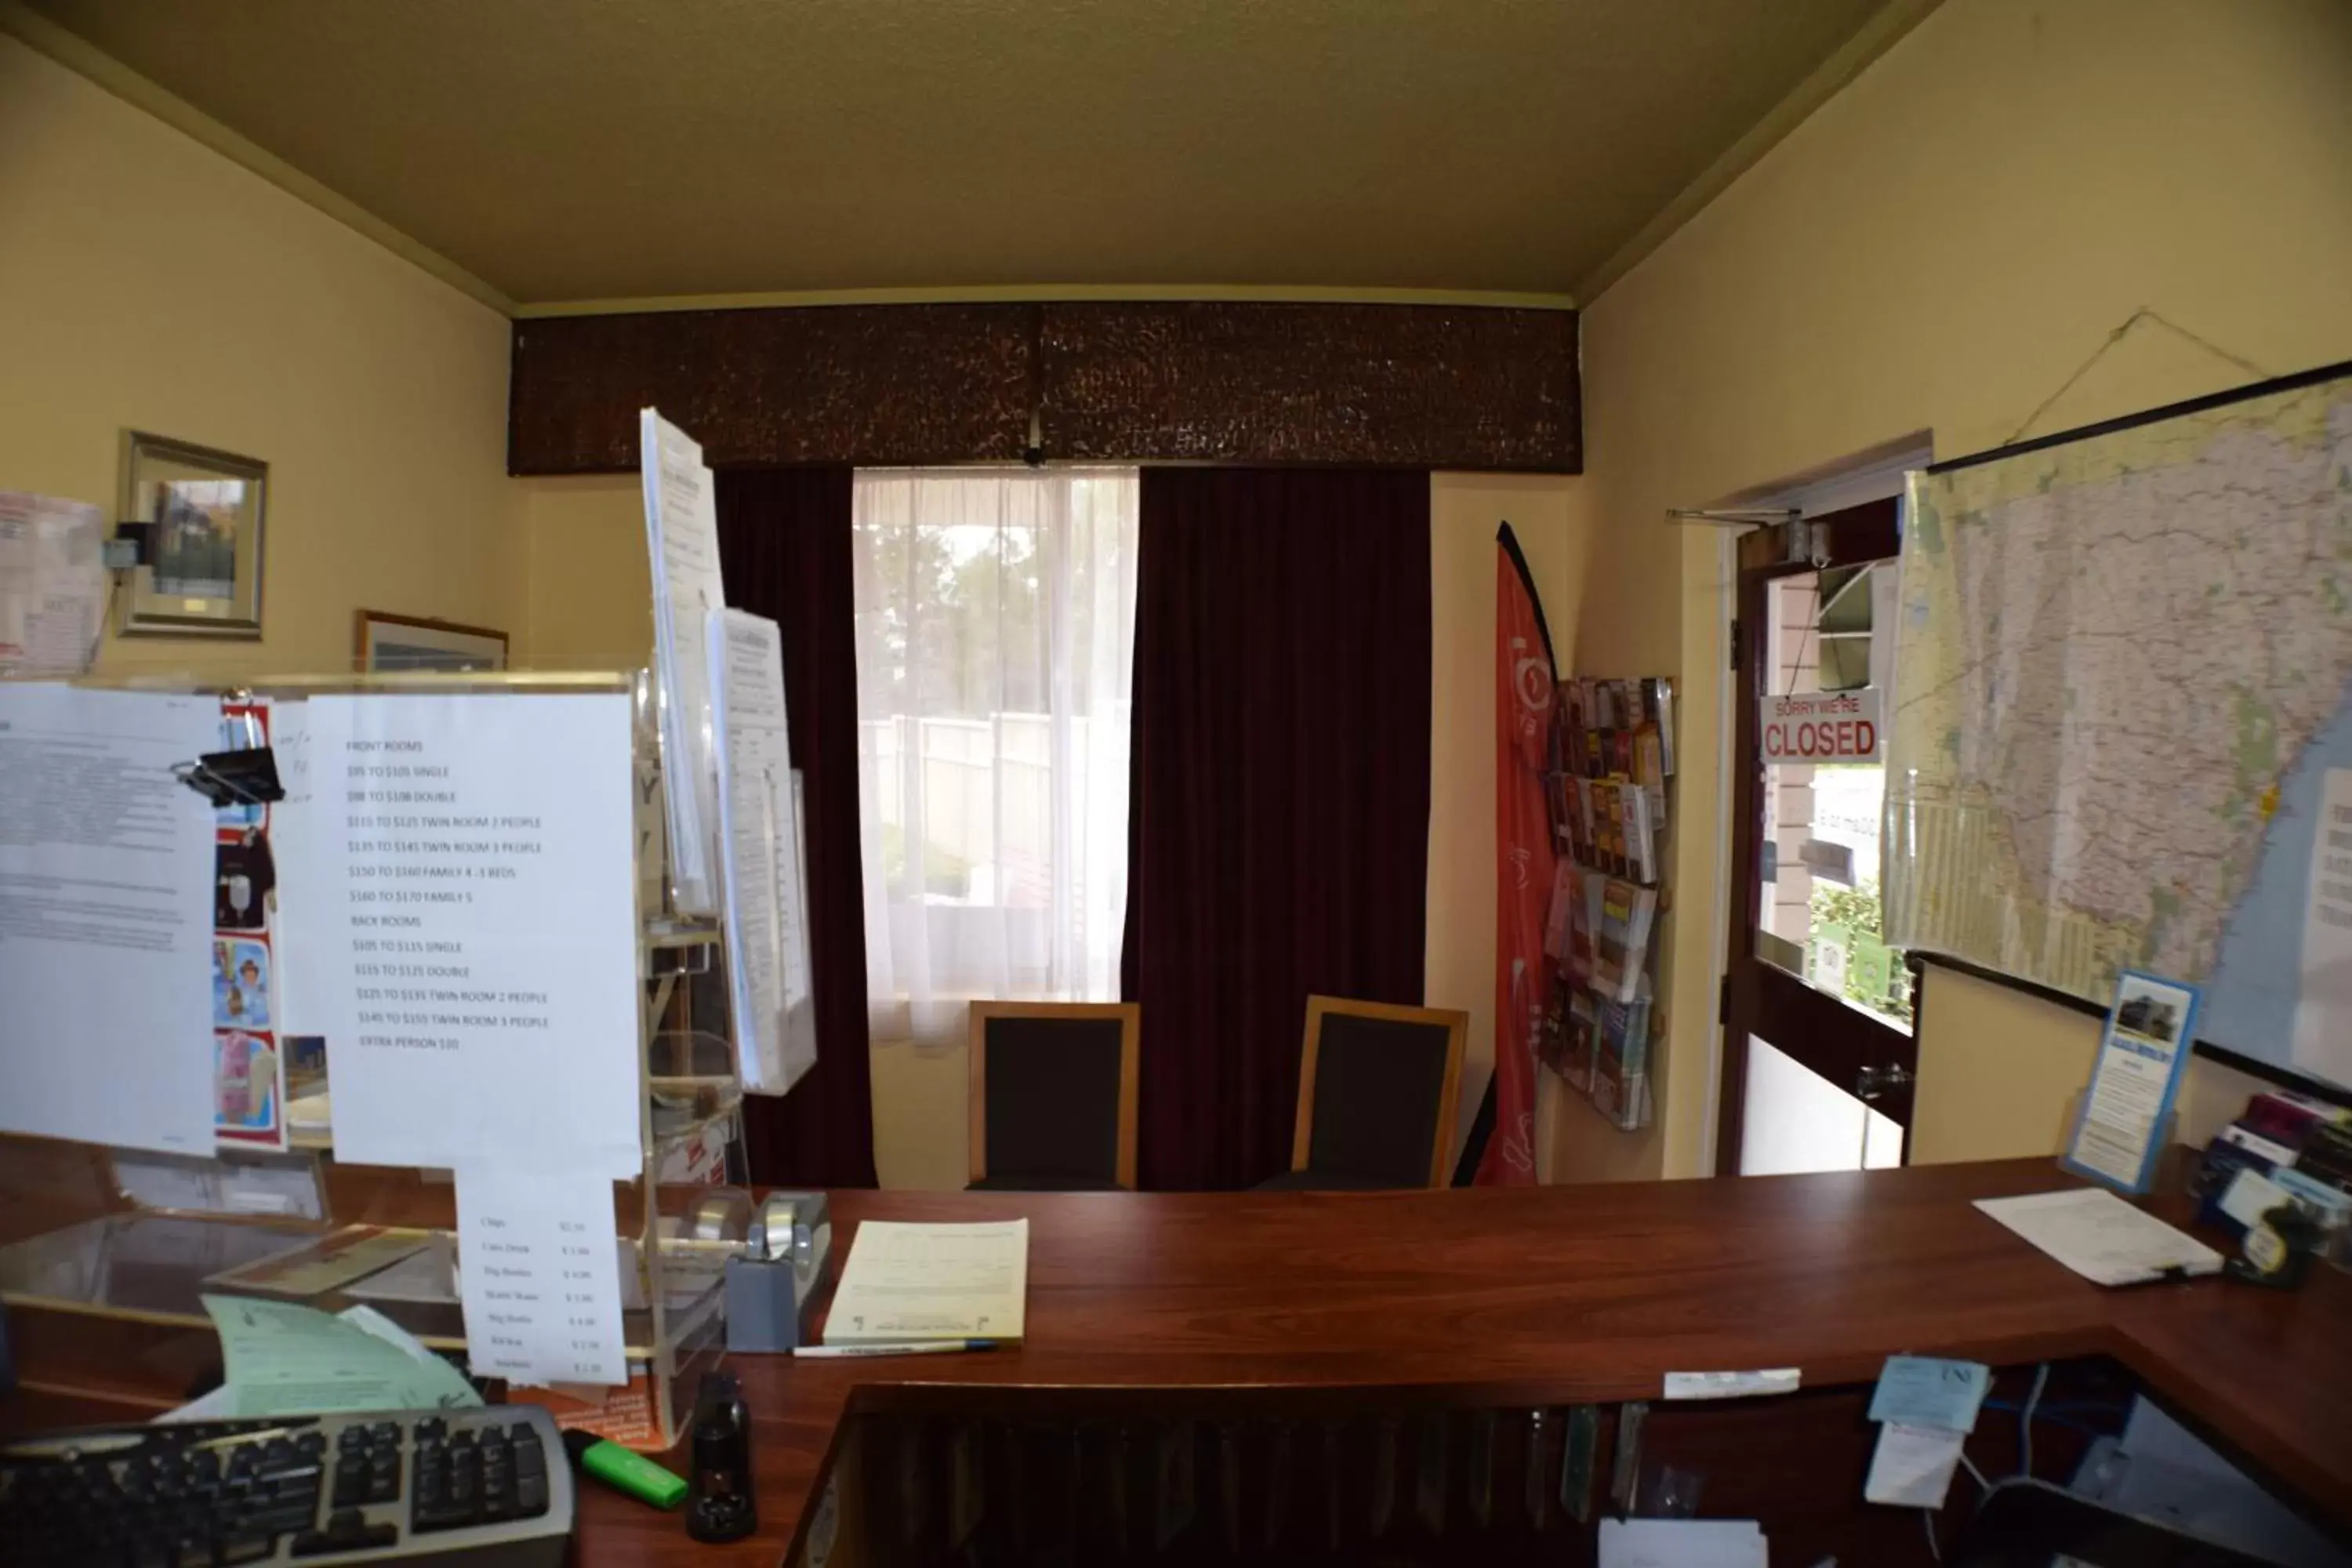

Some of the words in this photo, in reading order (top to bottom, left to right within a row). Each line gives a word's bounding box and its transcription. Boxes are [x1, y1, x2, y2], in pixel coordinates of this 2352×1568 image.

[1776, 700, 1814, 716] SORRY
[1817, 698, 1860, 713] WE'RE
[1766, 721, 1875, 756] CLOSED
[346, 739, 382, 752] FRONT
[384, 740, 423, 753] ROOMS
[369, 767, 384, 777] TO
[413, 766, 449, 778] SINGLE
[369, 791, 384, 802] TO
[413, 791, 456, 803] DOUBLE
[376, 816, 391, 827] TO
[394, 816, 419, 828] $125
[421, 817, 450, 828] TWIN
[452, 817, 489, 828] ROOM
[500, 816, 541, 829] PEOPLE
[348, 840, 374, 853] $135
[377, 840, 393, 851] TO
[394, 841, 419, 853] $145
[422, 841, 451, 853] TWIN
[454, 842, 489, 853] ROOM
[502, 841, 541, 854] PEOPLE
[348, 866, 376, 877] $150
[379, 866, 393, 877] TO
[395, 866, 422, 878] $160
[421, 866, 463, 878] FAMILY
[350, 891, 376, 902] $160
[379, 891, 394, 902] TO
[395, 891, 423, 903] $170
[424, 891, 463, 903] FAMILY
[350, 916, 378, 927] BACK
[380, 916, 421, 927] ROOMS
[380, 941, 395, 951] TO
[426, 942, 463, 953] SINGLE
[382, 964, 397, 976] TO
[426, 966, 470, 979] DOUBLE
[383, 989, 399, 1000] TO
[430, 989, 459, 1002] TWIN
[460, 991, 496, 1003] ROOM
[507, 992, 547, 1004] PEOPLE
[386, 1013, 401, 1024] TO
[431, 1014, 460, 1025] TWIN
[463, 1015, 498, 1029] ROOM
[510, 1017, 549, 1029] PEOPLE
[359, 1036, 393, 1047] EXTRA
[394, 1036, 437, 1048] PERSON
